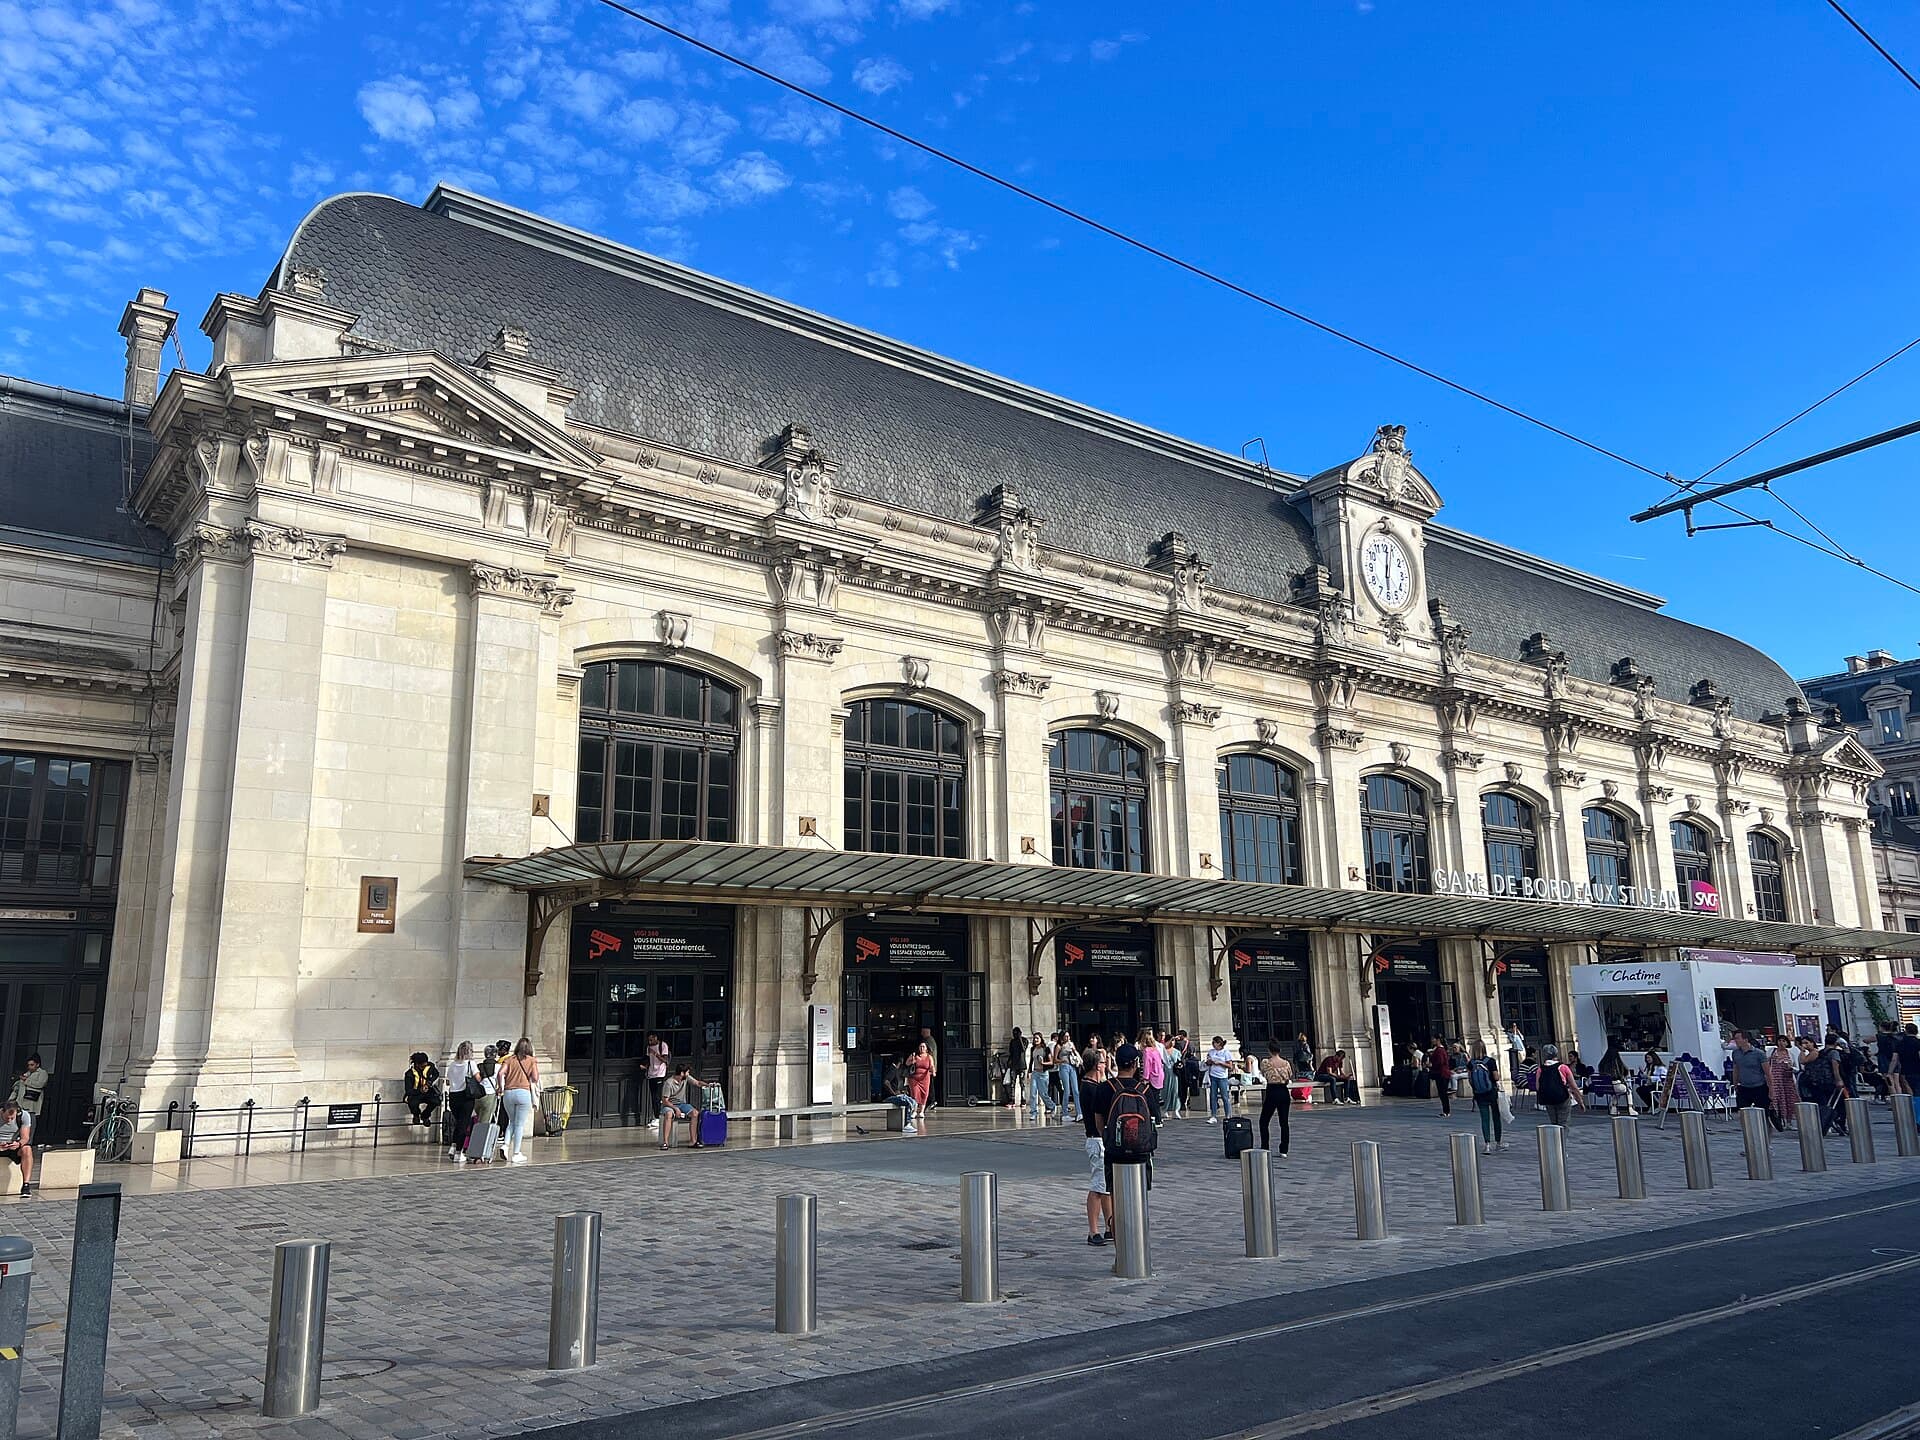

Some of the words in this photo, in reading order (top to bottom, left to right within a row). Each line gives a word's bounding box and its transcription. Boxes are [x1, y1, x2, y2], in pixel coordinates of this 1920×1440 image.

[1374, 543, 1380, 553] 11
[1381, 543, 1389, 553] 12
[1369, 551, 1377, 561] 10
[1369, 562, 1374, 572] 9
[1397, 558, 1402, 568] 2
[1371, 575, 1377, 585] 8
[1400, 571, 1405, 581] 3
[1378, 585, 1384, 596] 7
[1386, 591, 1391, 600] 6
[1394, 590, 1399, 600] 5
[1434, 868, 1488, 895] GARE
[1493, 873, 1518, 895] DE
[1523, 876, 1616, 903] BORDEAUX
[1618, 884, 1636, 904] ST
[1642, 887, 1680, 909] JEAN
[1694, 891, 1718, 907] SNCF
[1612, 968, 1661, 982] Chatime
[1791, 986, 1819, 1001] Chatime
